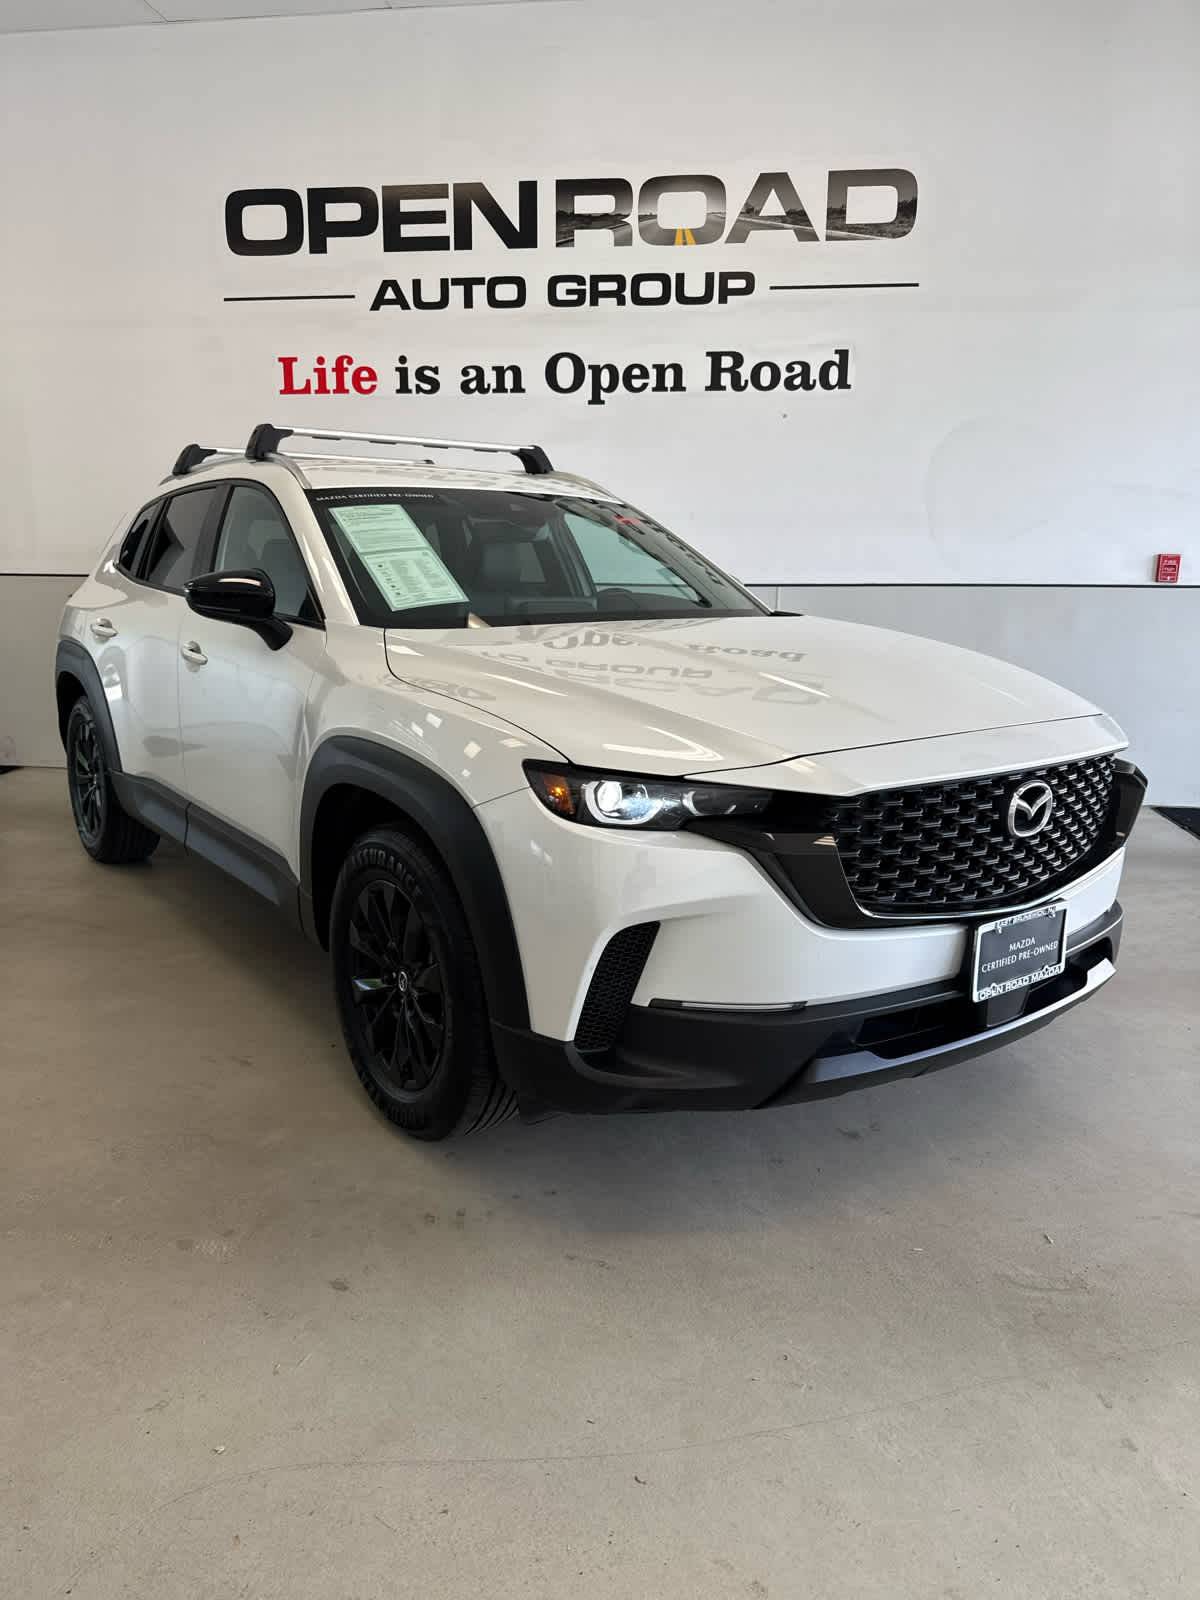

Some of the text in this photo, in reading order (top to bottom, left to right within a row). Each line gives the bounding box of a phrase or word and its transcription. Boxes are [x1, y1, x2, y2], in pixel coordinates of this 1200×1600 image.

[225, 169, 918, 256] OPEN ROAD
[370, 272, 755, 311] AUTO GROUP
[278, 349, 851, 405] Life is an Open Road
[981, 940, 1059, 973] CERTIFIED PRE-OWNED
[1009, 937, 1036, 952] MAZDA
[979, 967, 1062, 1000] OPEN ROAD MAZDA
